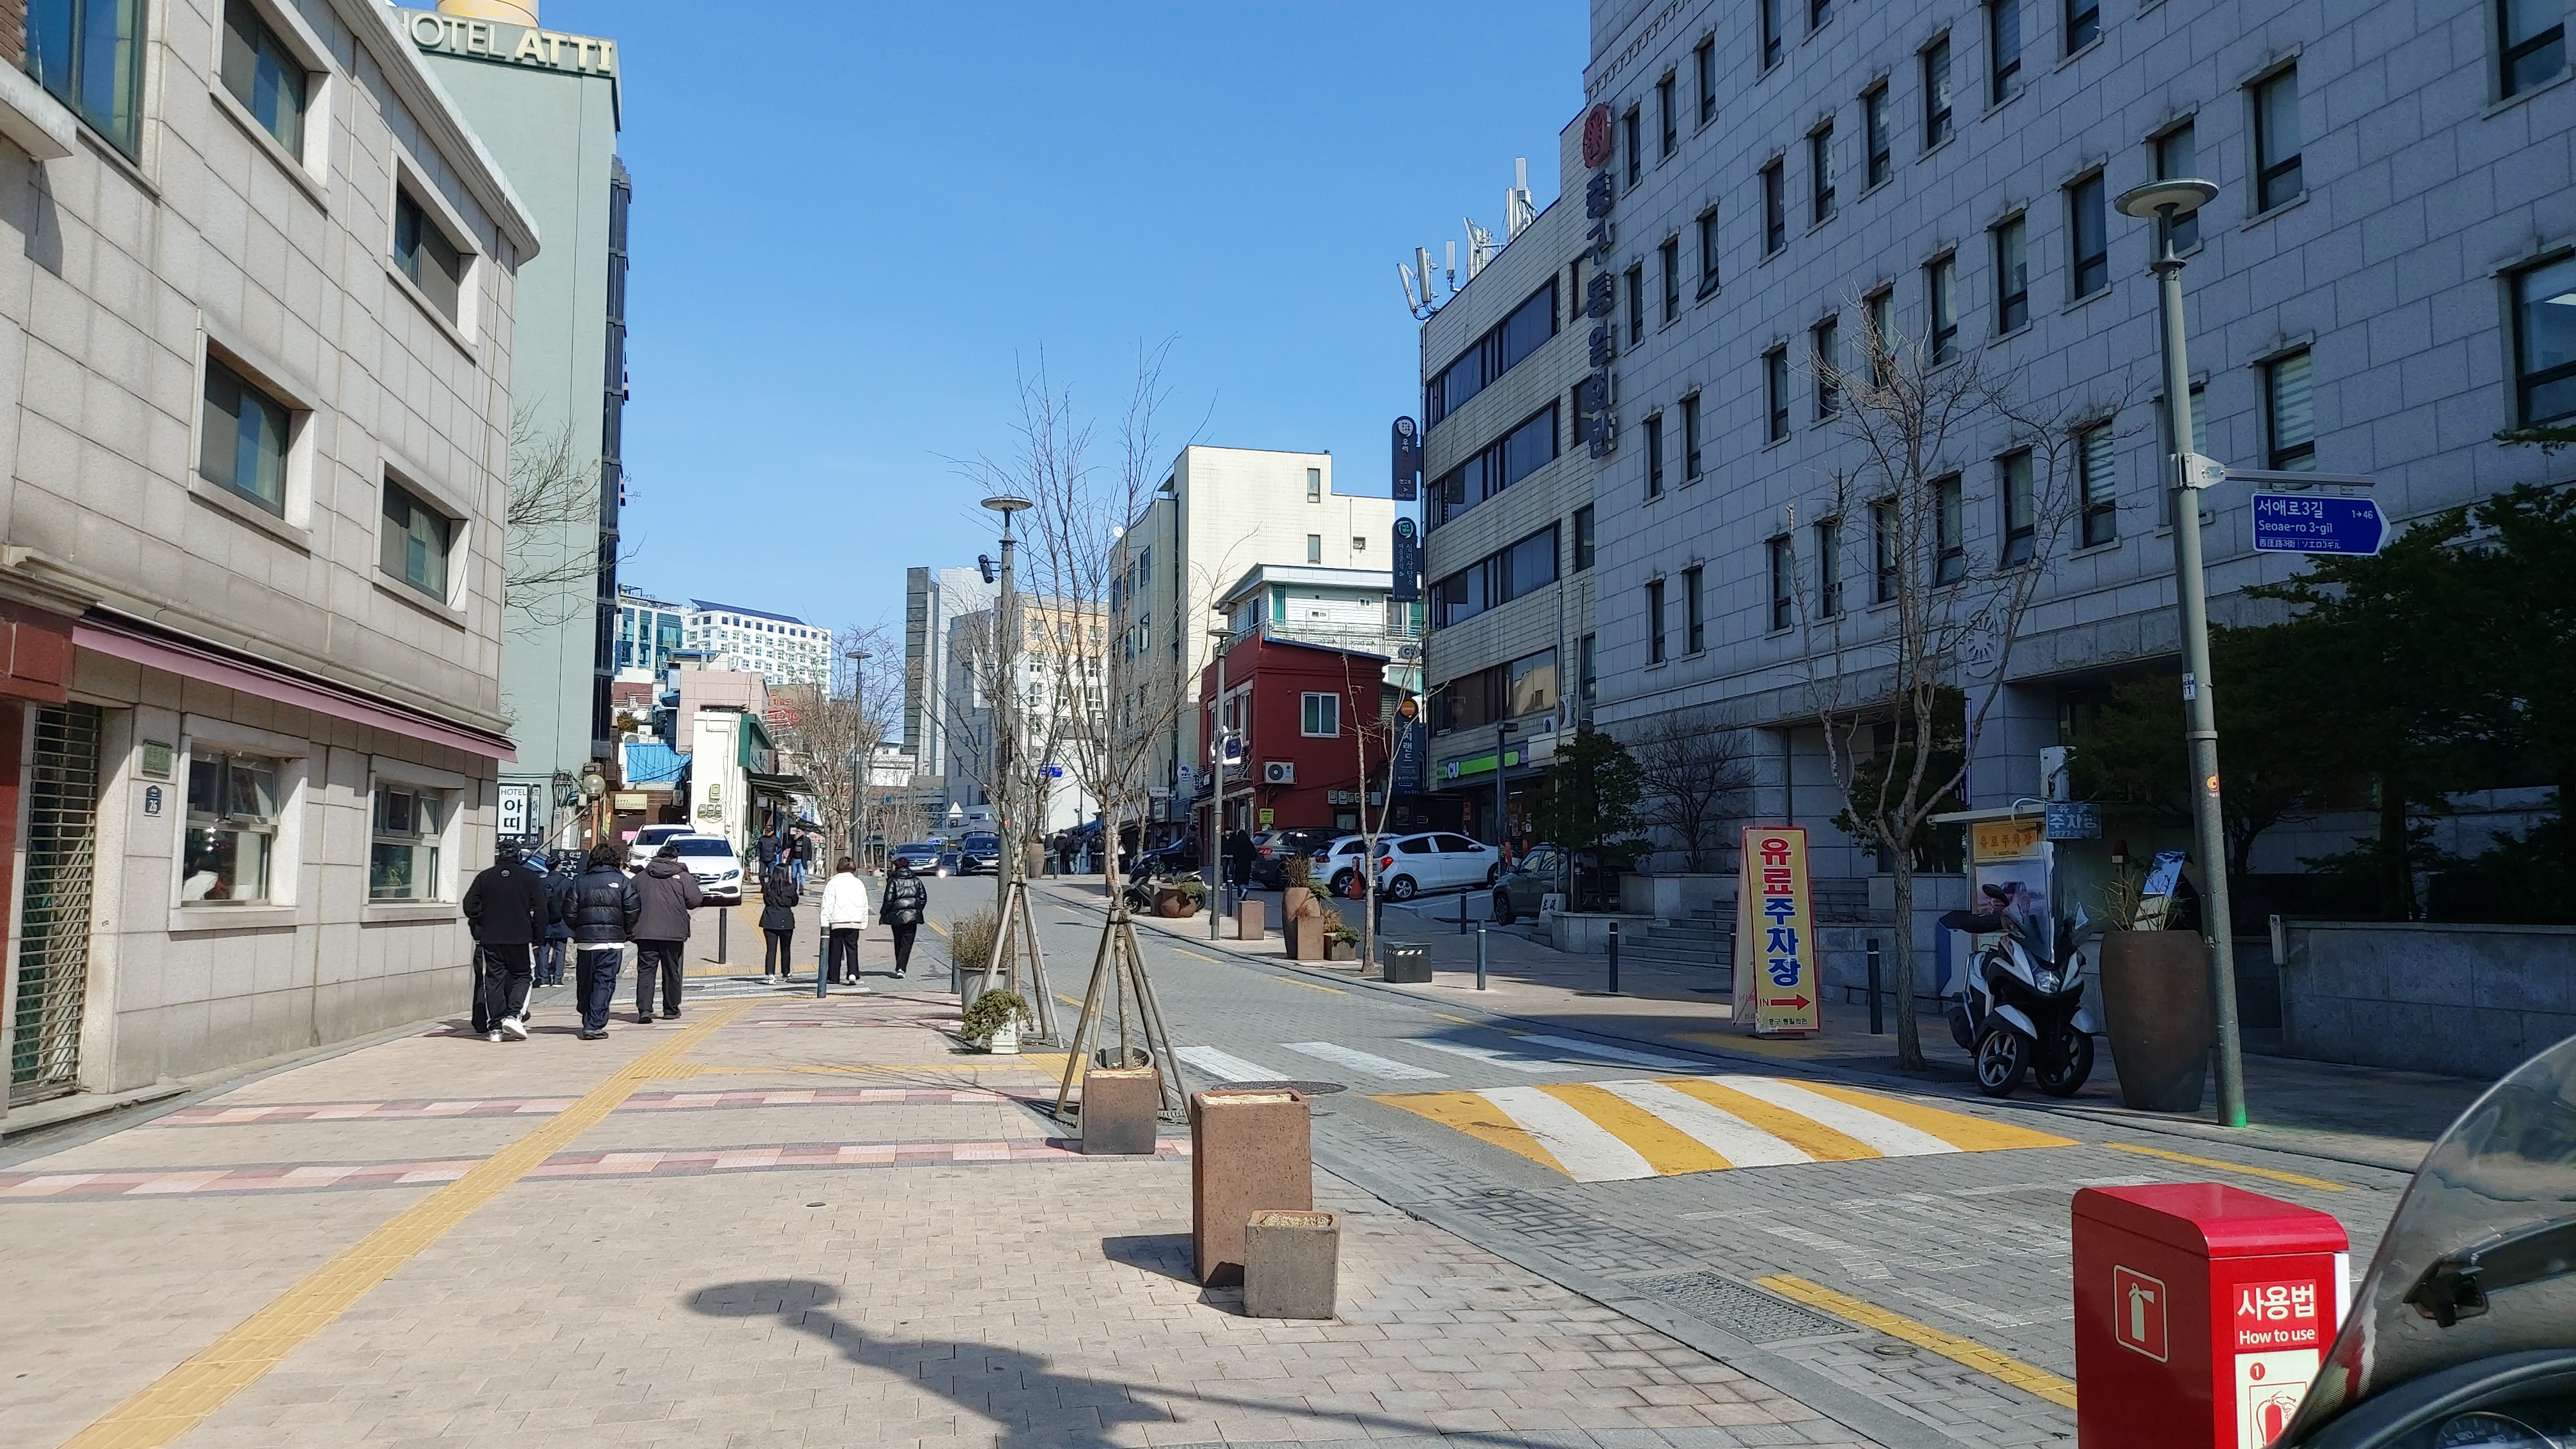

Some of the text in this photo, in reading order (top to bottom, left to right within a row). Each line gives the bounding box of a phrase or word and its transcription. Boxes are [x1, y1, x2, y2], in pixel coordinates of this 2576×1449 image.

[515, 29, 613, 72] ATTI
[2258, 498, 2324, 519] 서애로3길
[2258, 520, 2333, 535] Seoae-ro 3-gil
[1448, 761, 1459, 779] CU
[500, 788, 527, 797] HOTEL
[503, 799, 523, 831] 아띠
[1759, 997, 1769, 1007] IN
[2237, 1284, 2315, 1321] 사용법
[2239, 1328, 2315, 1344] How to use
